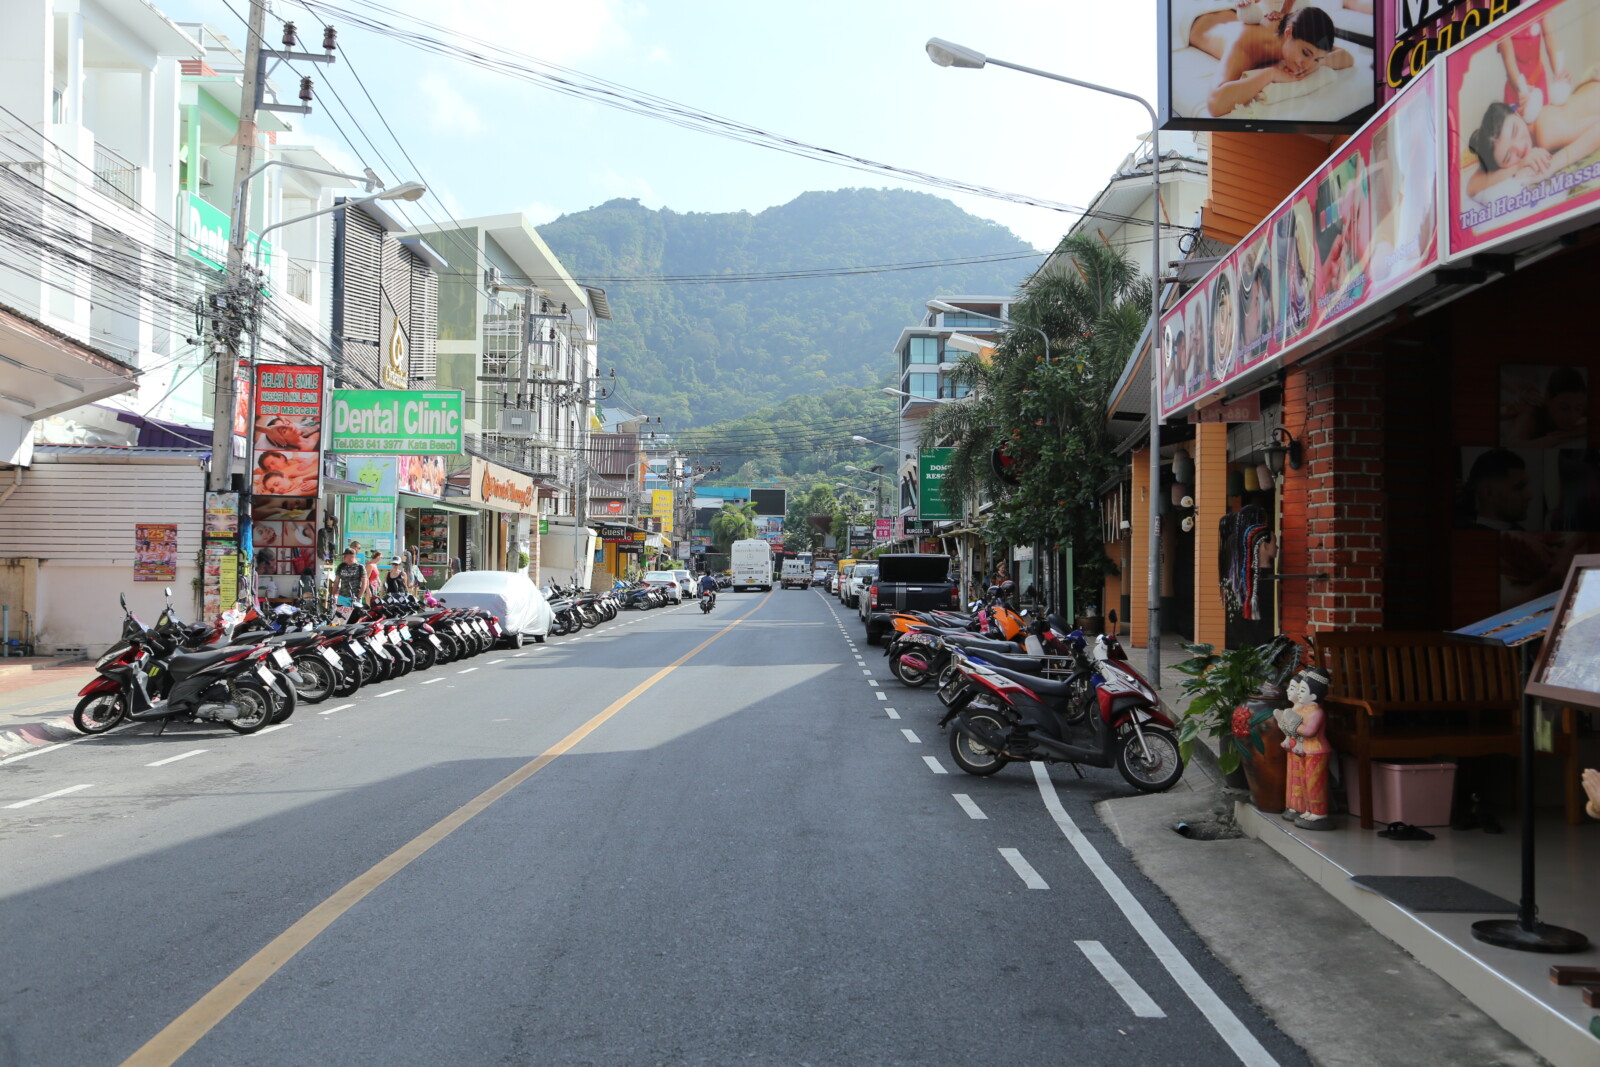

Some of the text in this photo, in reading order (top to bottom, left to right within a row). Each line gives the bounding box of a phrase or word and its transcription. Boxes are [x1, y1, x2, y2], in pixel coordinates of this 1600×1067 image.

[1460, 202, 1493, 230] Thai
[1494, 180, 1546, 219] Herbal
[261, 372, 285, 389] RELAX
[287, 373, 294, 389] &
[295, 373, 319, 390] SMILE
[334, 400, 459, 435] Dental Clinic
[366, 439, 380, 449] 641
[383, 440, 404, 449] 3977
[408, 440, 427, 450] Kata
[429, 440, 456, 450] Beach
[601, 527, 624, 536] Guest
